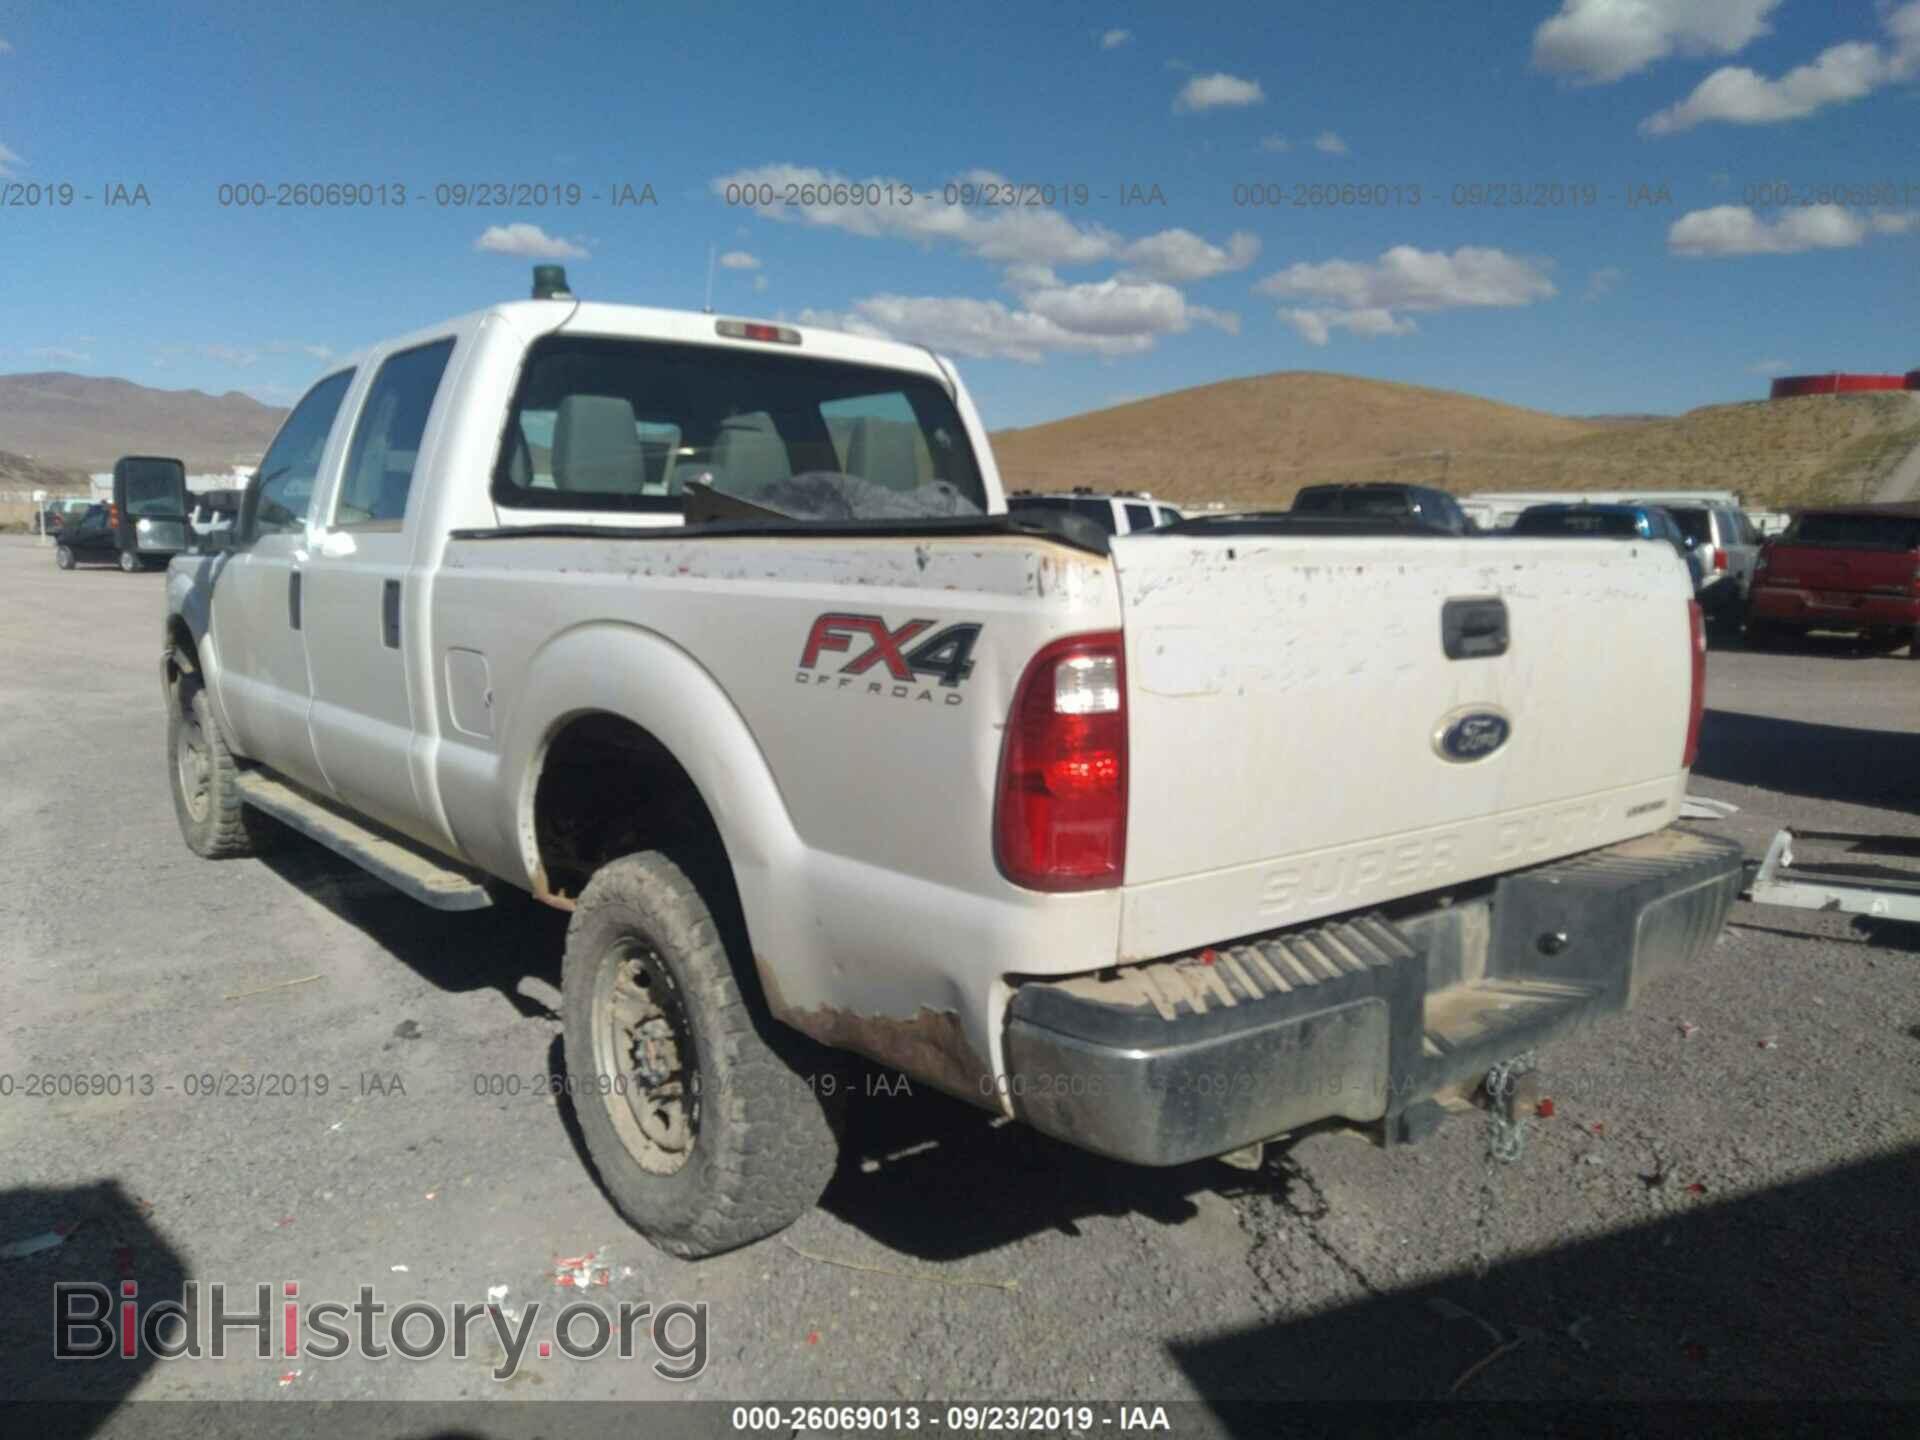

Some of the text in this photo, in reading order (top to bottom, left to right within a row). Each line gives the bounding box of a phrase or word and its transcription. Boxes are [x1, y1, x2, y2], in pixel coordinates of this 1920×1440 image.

[799, 612, 984, 688] FX4
[795, 671, 963, 706] OFF ROAD
[1258, 832, 1462, 916] SUPER
